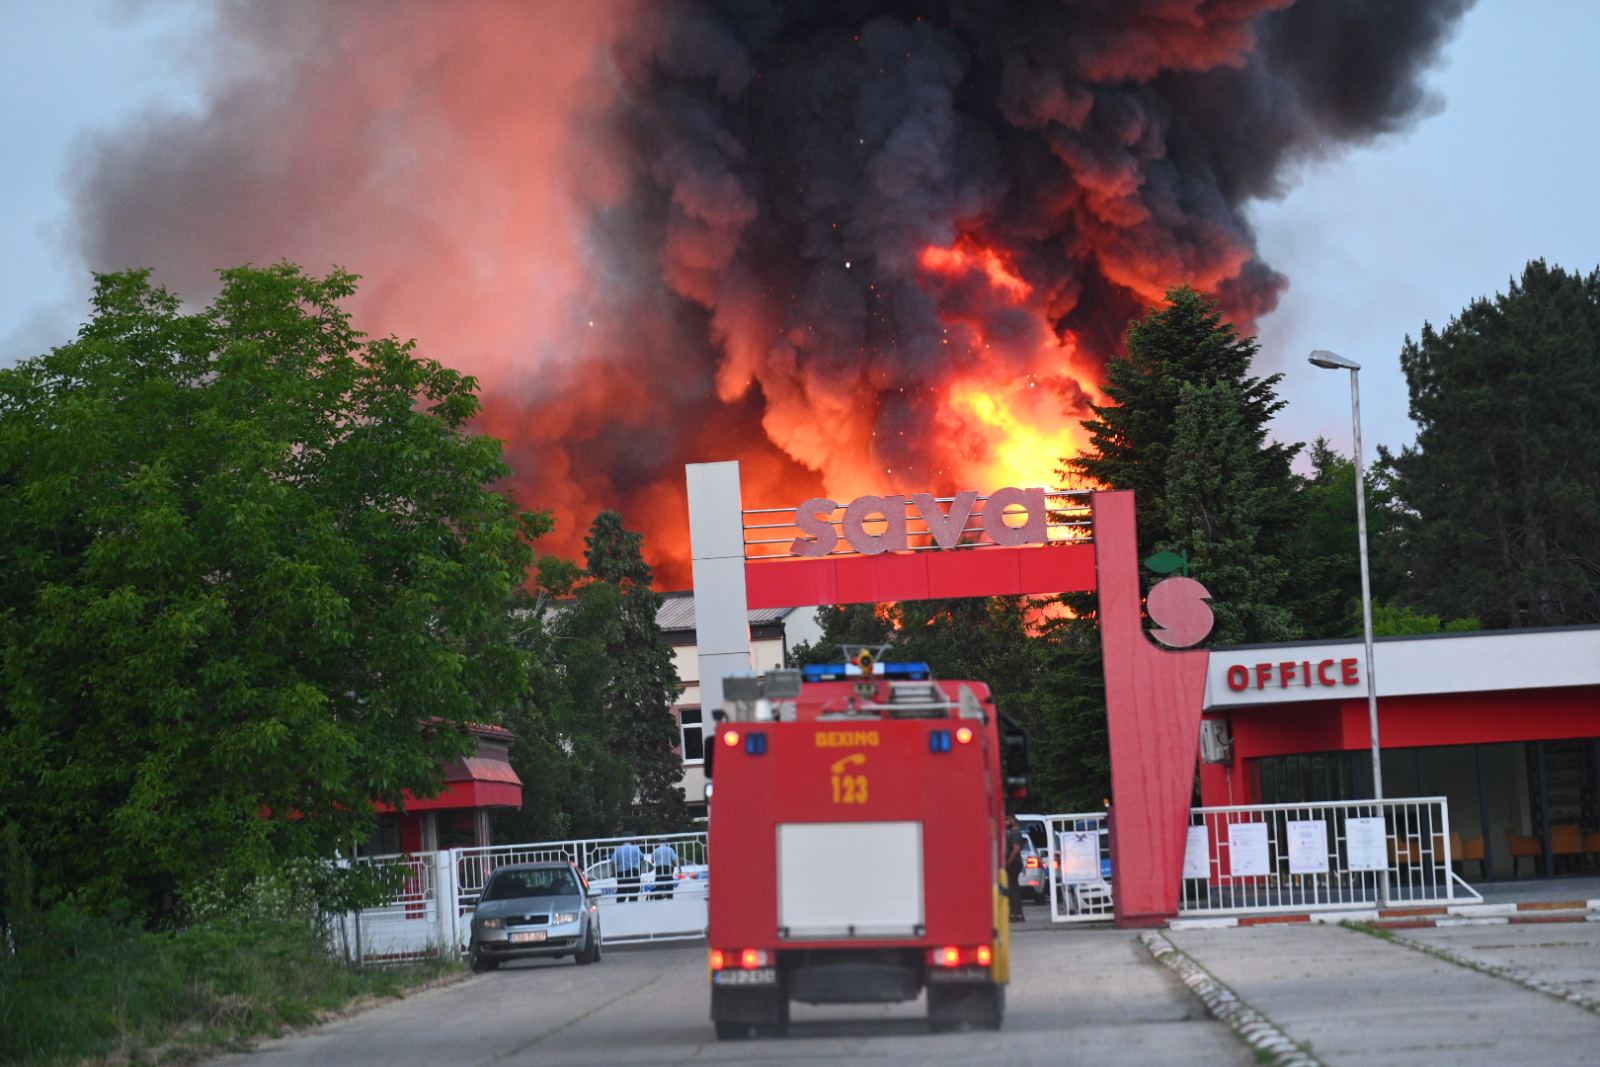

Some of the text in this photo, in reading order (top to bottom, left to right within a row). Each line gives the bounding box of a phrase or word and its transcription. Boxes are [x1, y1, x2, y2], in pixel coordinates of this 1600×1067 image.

[790, 487, 1048, 557] sava
[1227, 658, 1360, 692] OFFICE
[831, 775, 869, 805] 123
